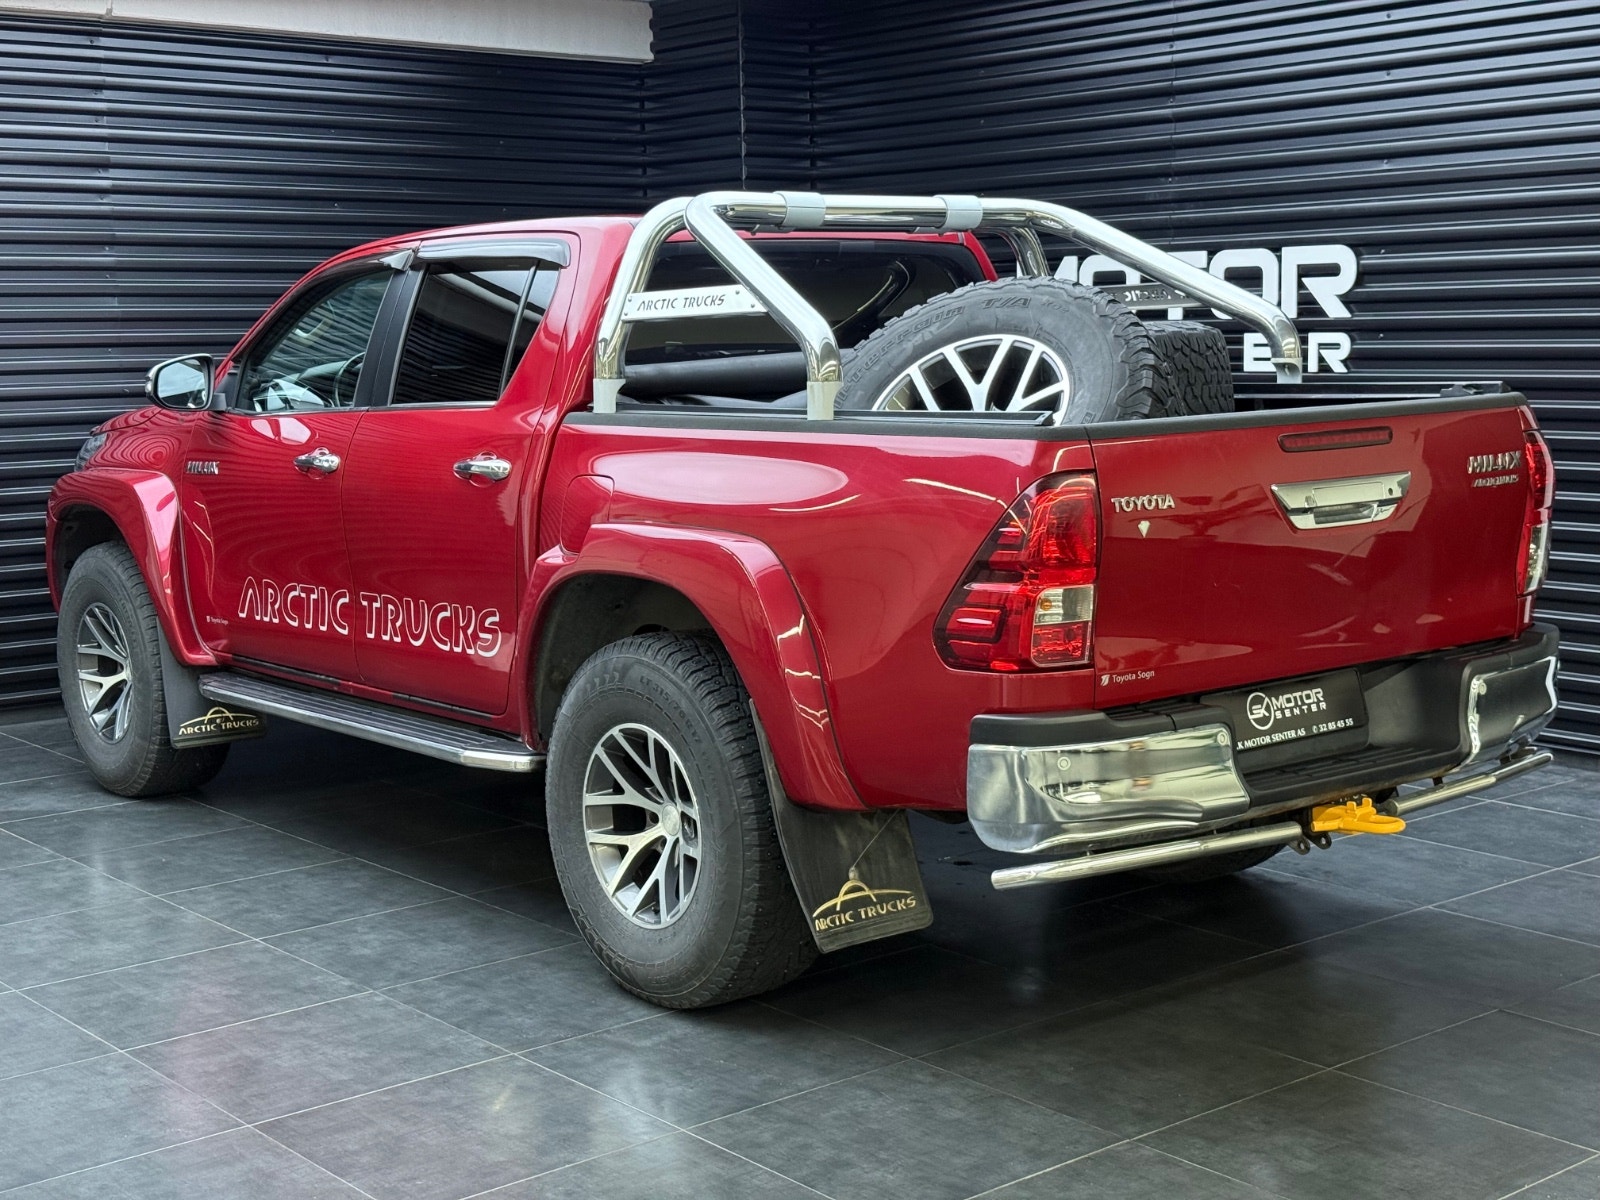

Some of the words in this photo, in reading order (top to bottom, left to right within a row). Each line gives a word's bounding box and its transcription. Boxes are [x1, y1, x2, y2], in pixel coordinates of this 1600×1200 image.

[636, 297, 679, 312] ARCTIC
[683, 294, 727, 309] TRUCKS
[1466, 450, 1522, 474] HILUX
[1110, 494, 1176, 513] TOYOTA
[238, 576, 350, 636] ARCTIC
[360, 592, 502, 658] TRUCKS
[1112, 673, 1136, 684] Toyota
[1137, 670, 1155, 680] Sogn
[1271, 688, 1325, 711] MOTOR
[1274, 702, 1327, 720] SENTER
[178, 723, 217, 736] ARCTIC
[221, 718, 259, 731] TRUCKS
[1244, 735, 1272, 748] MOTOR
[1271, 729, 1297, 742] SENTER
[1297, 728, 1307, 738] AS
[814, 910, 855, 931] ARCTIC
[858, 895, 917, 920] TRUCKS
